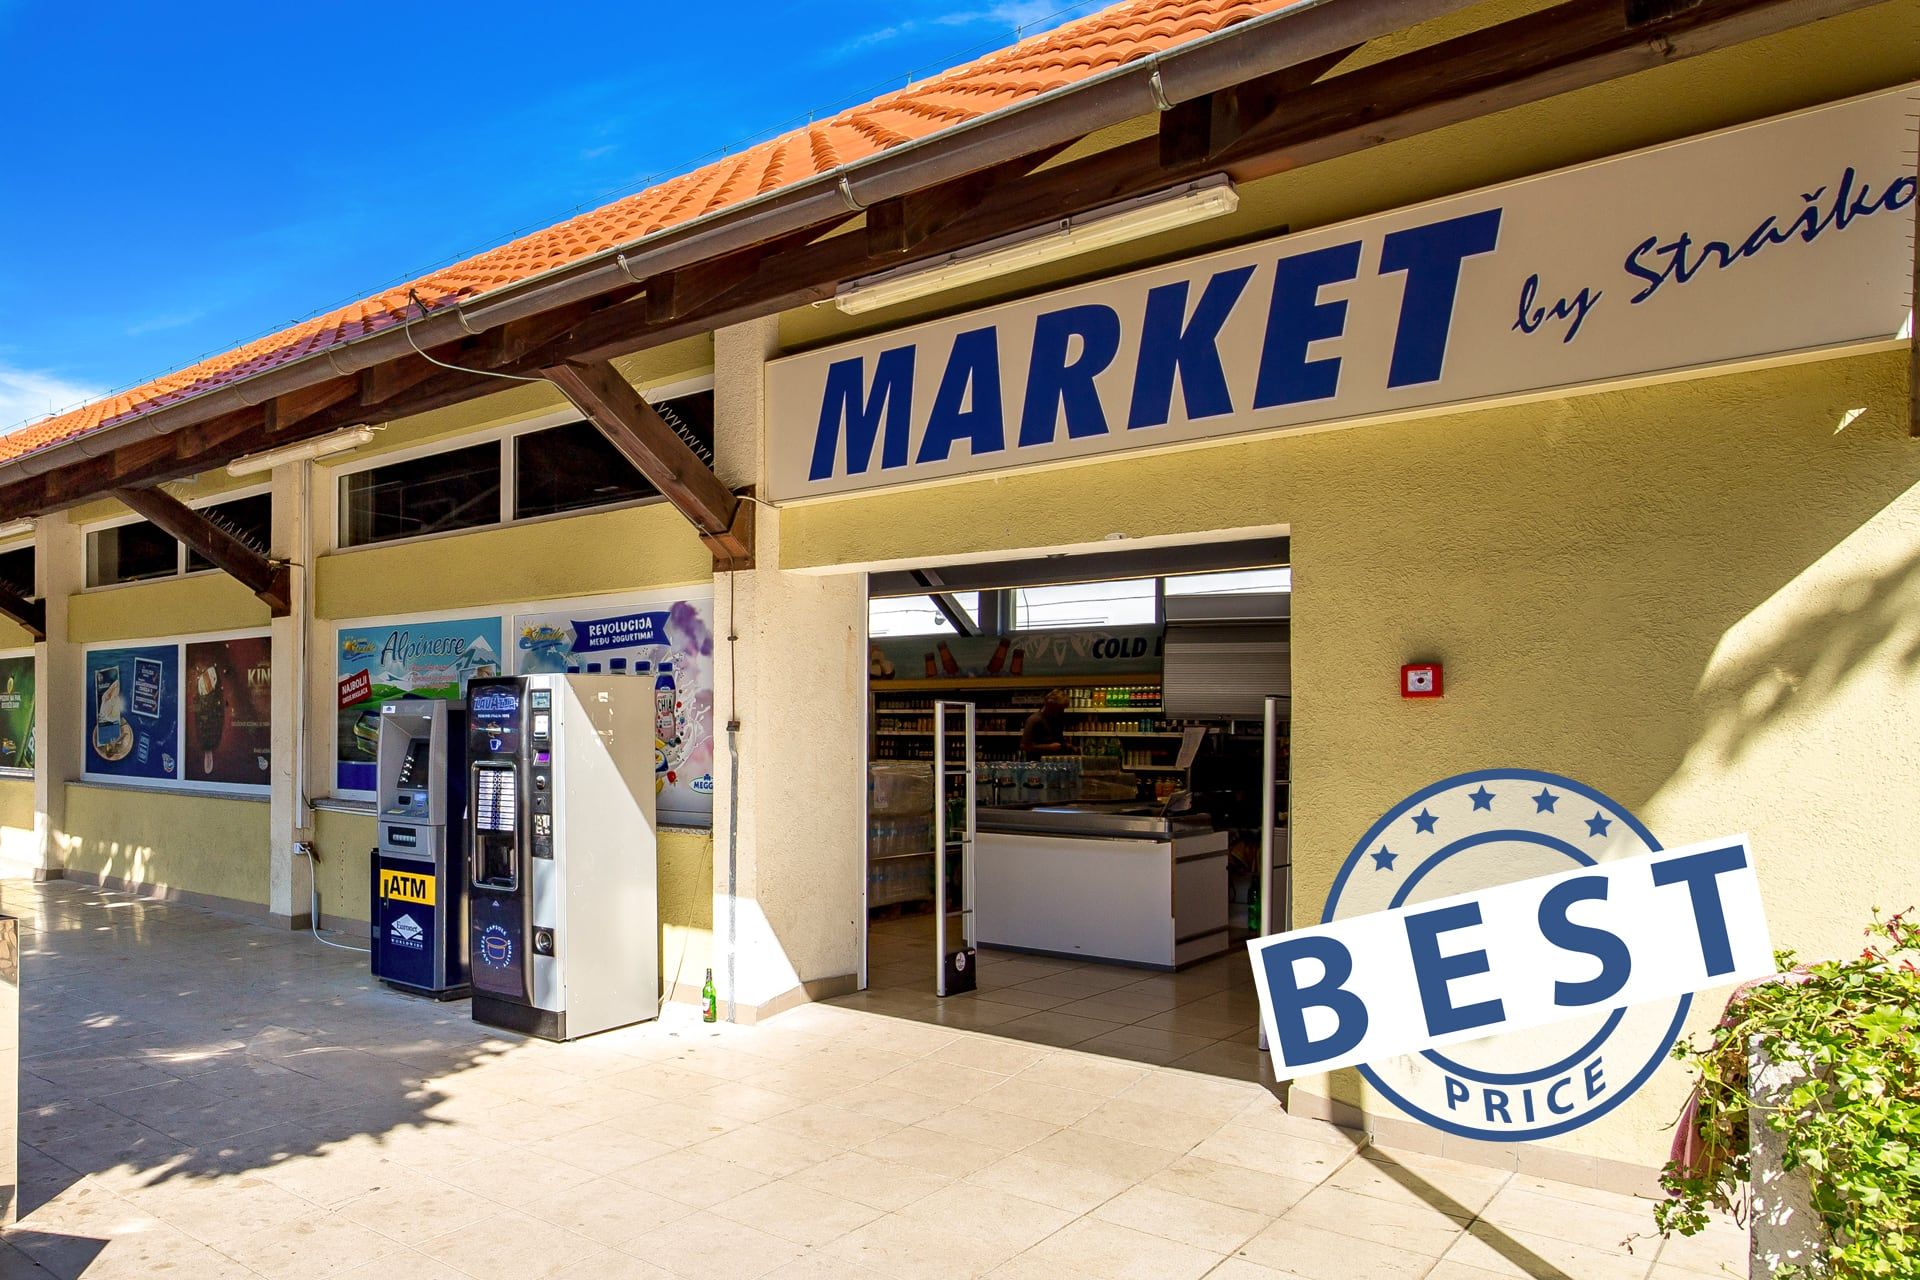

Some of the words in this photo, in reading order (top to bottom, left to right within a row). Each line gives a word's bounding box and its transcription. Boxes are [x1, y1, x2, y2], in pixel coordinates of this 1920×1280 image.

[808, 207, 1503, 482] MARKET
[1511, 273, 1602, 343] by
[1624, 167, 1917, 304] Straško
[589, 617, 653, 637] REVOLUCIJA
[381, 630, 465, 668] Alpinesse
[1092, 637, 1148, 659] COLD
[389, 875, 426, 899] ATM
